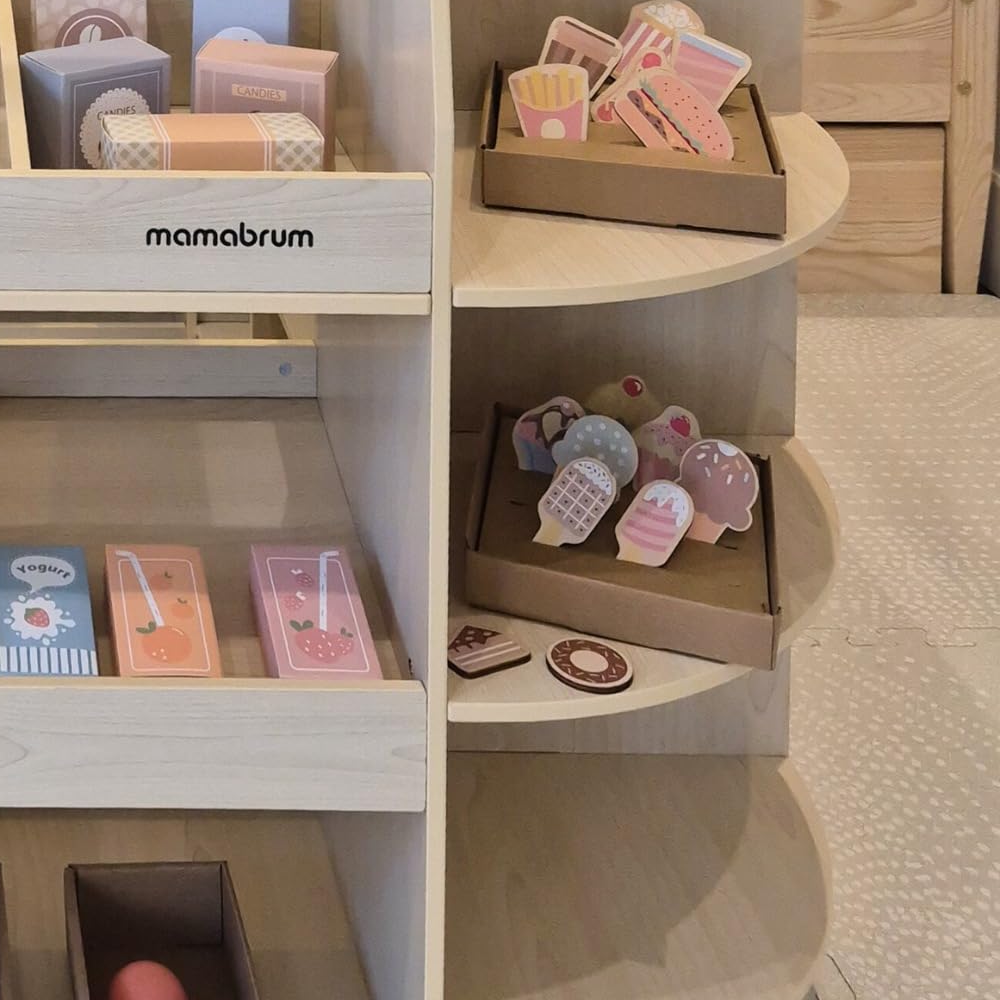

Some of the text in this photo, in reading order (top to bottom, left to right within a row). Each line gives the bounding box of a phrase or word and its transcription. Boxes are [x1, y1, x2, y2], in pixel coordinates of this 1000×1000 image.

[237, 87, 281, 100] CANDIES
[146, 221, 313, 247] mamabrum
[16, 563, 71, 579] Yogurt
